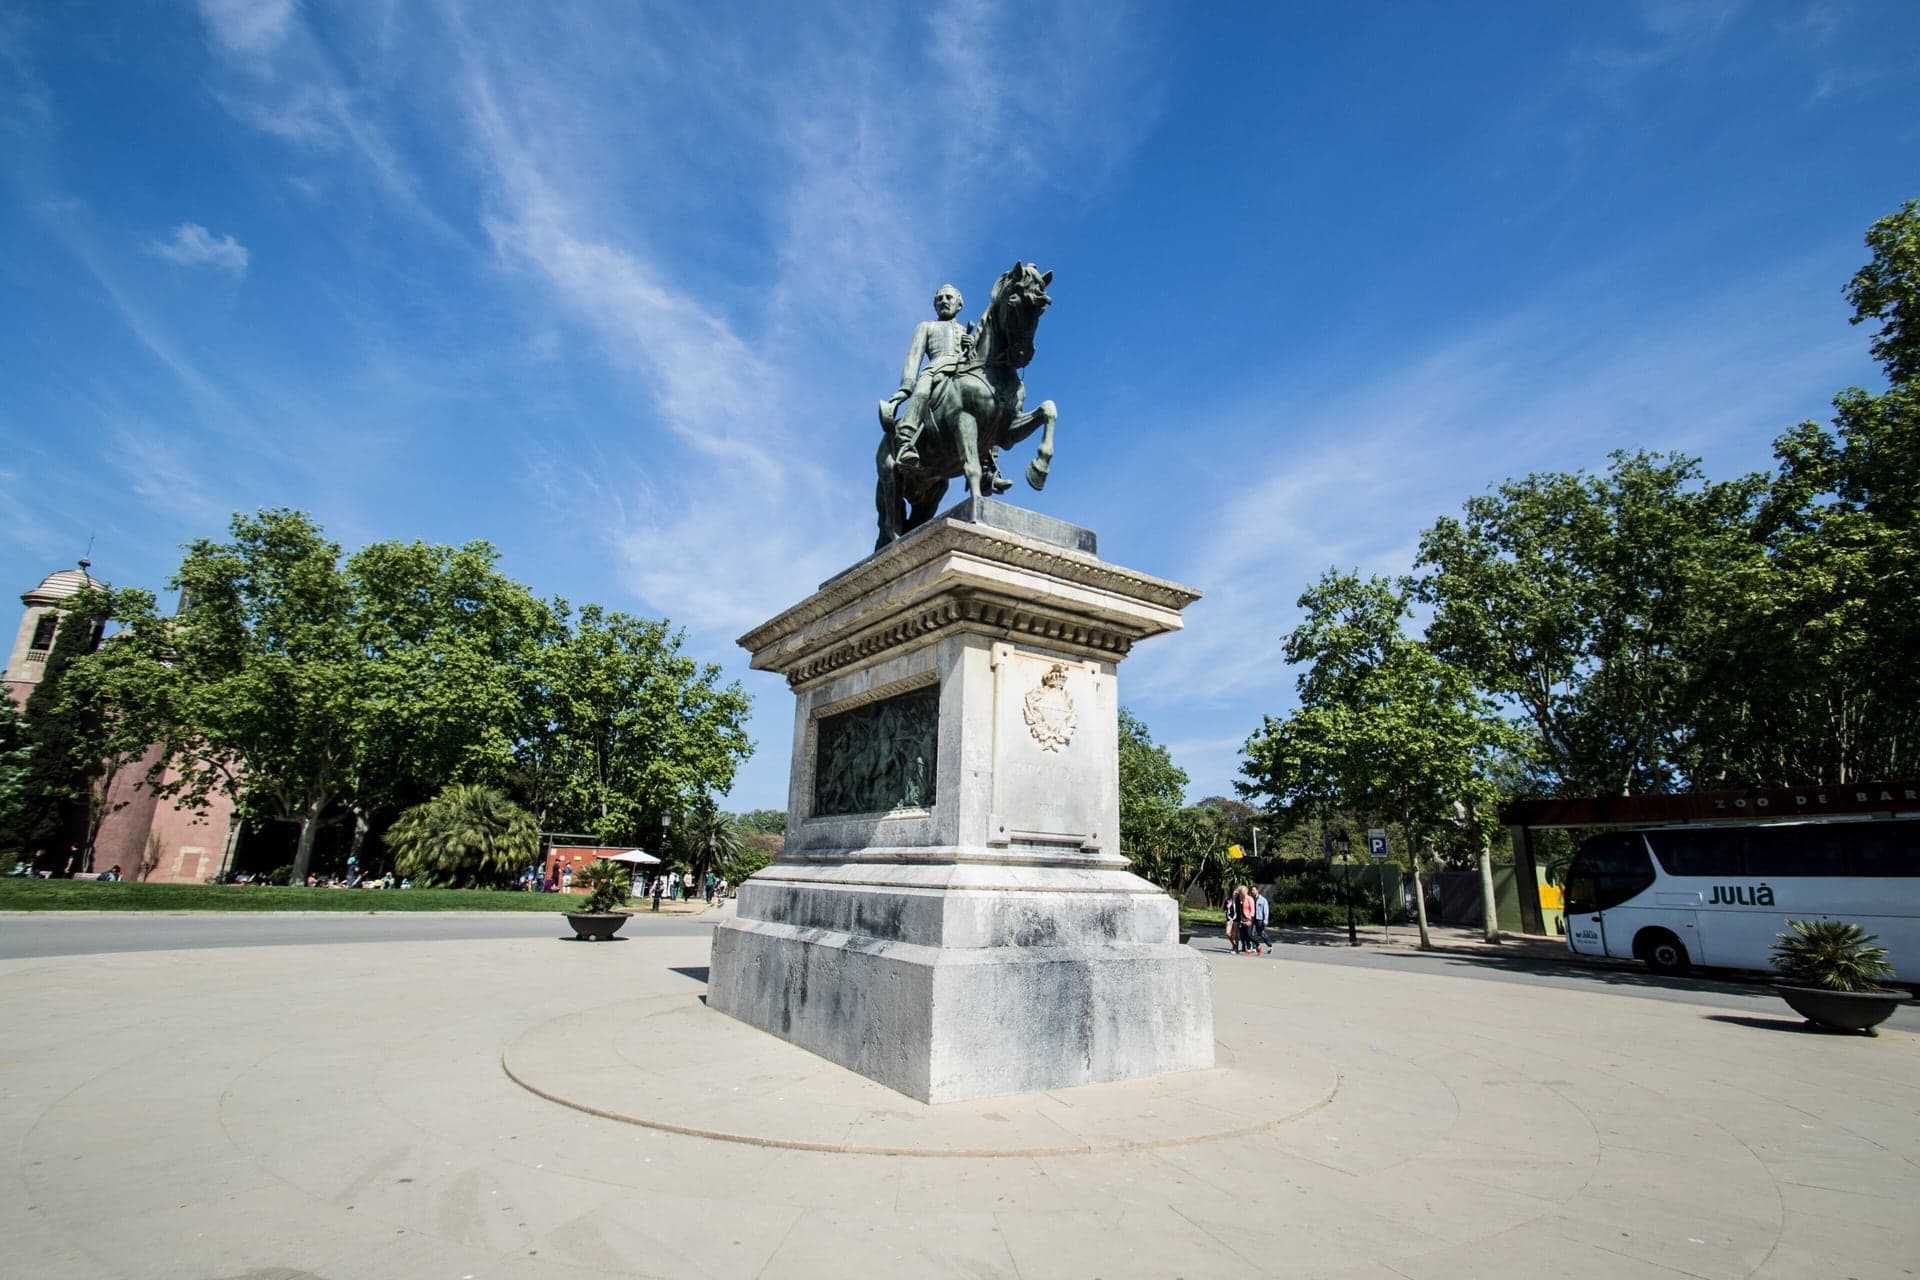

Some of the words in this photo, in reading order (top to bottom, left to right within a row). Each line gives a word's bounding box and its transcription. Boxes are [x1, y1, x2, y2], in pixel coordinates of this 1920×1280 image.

[1715, 797, 1769, 809] ZOO
[1796, 795, 1828, 805] DE
[1372, 839, 1383, 852] P
